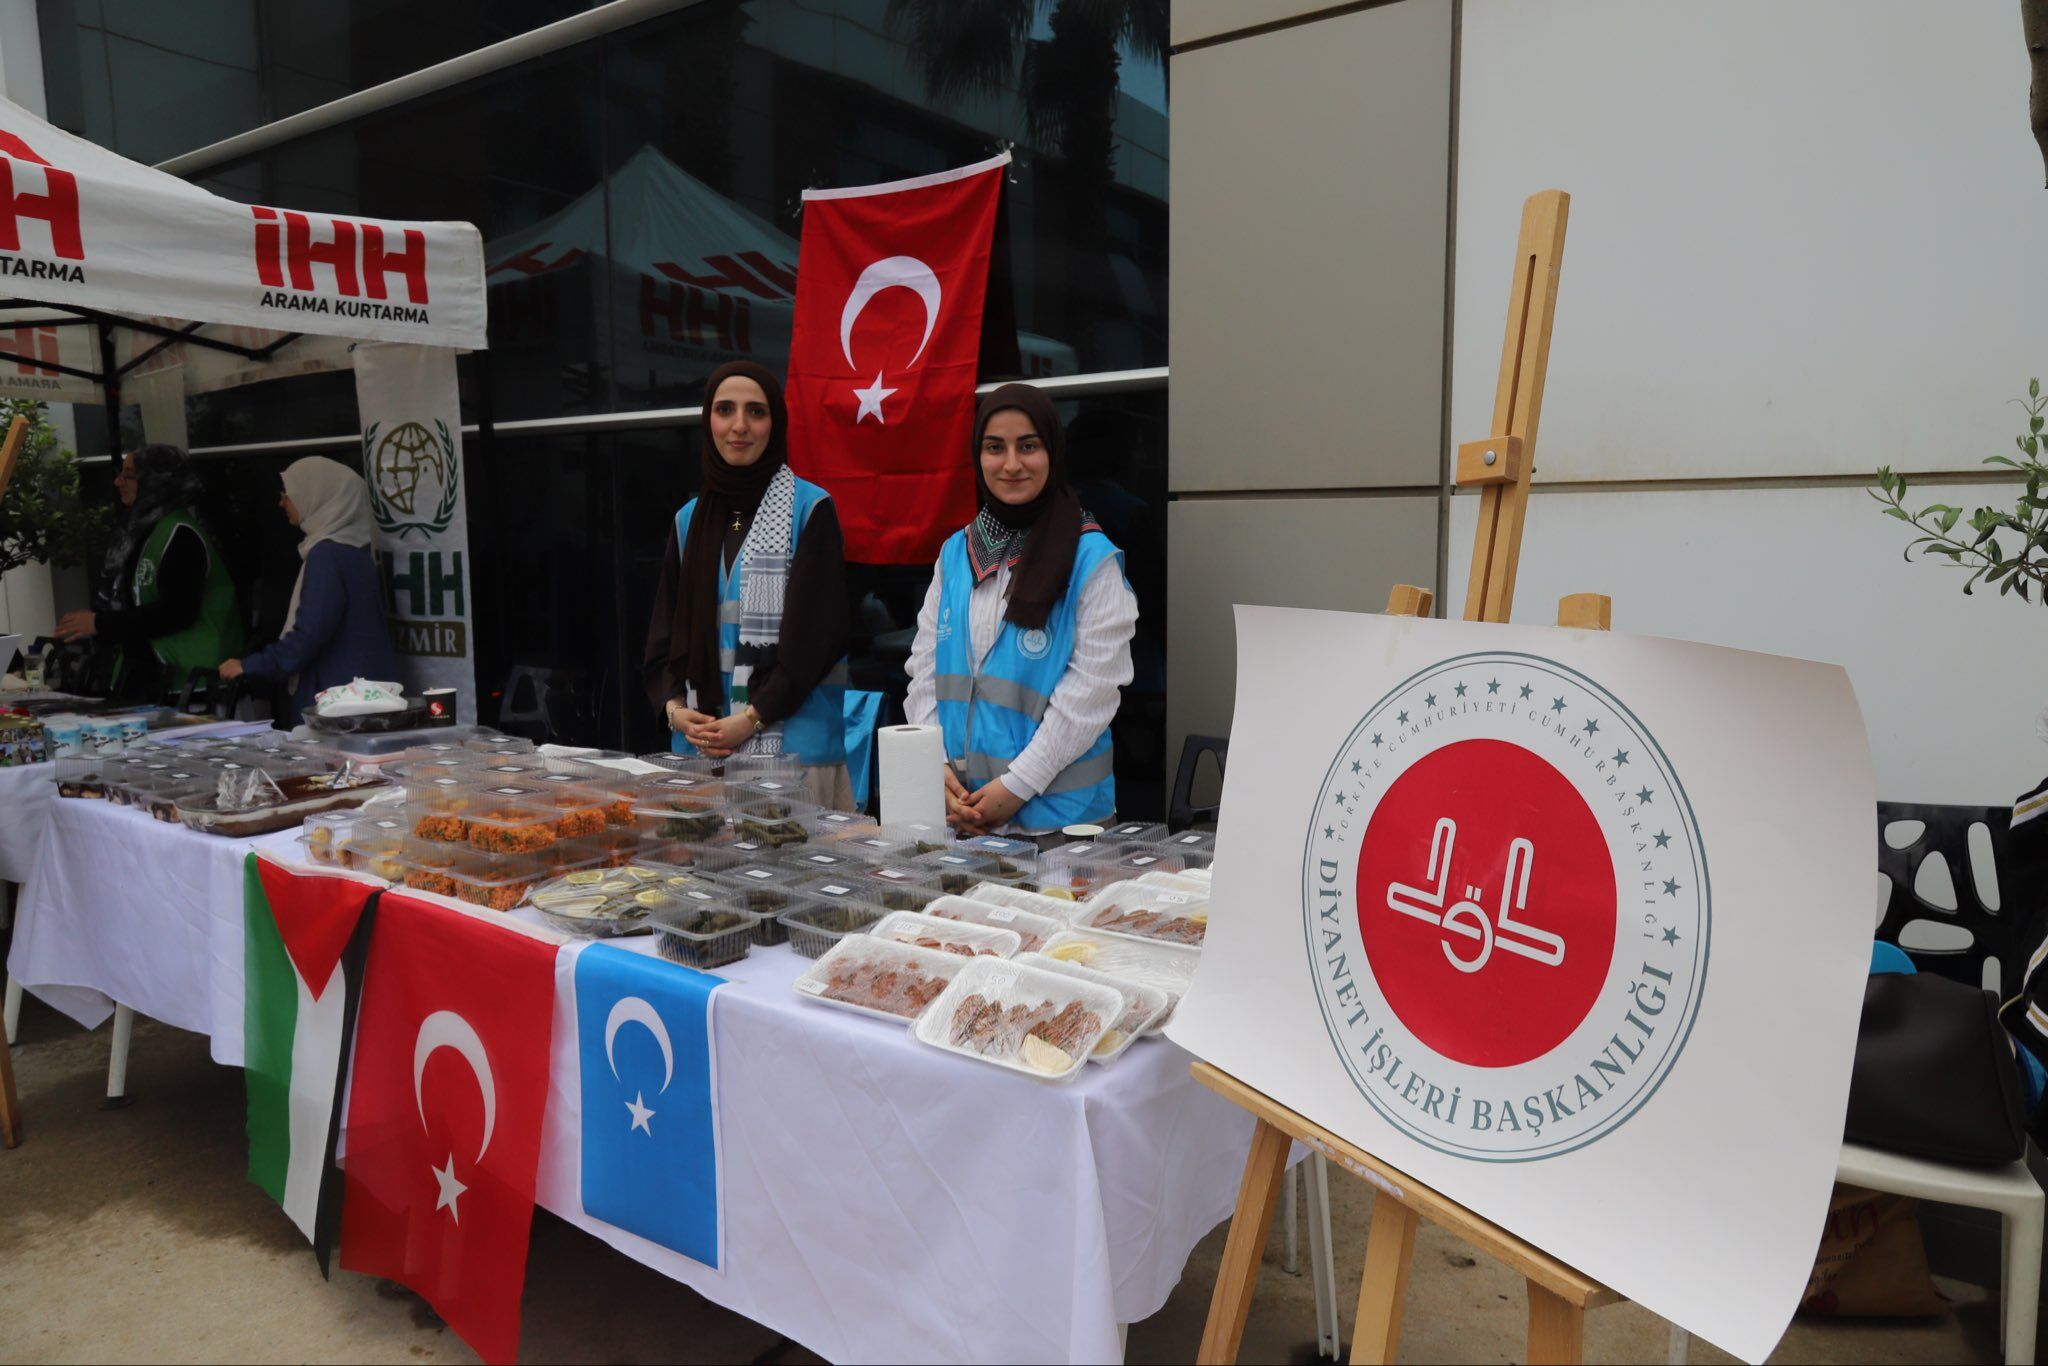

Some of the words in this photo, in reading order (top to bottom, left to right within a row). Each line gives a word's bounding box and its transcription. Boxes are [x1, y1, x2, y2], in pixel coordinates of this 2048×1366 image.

[260, 291, 329, 313] ARAMA
[334, 300, 429, 324] KURTARMA
[381, 551, 465, 616] HH
[1388, 701, 1517, 753] CUMHURİYETİ
[1528, 710, 1658, 940] CUMHURBAŞKANLIĞI
[1318, 857, 1370, 1029] DİYANET
[1360, 1027, 1462, 1125] İŞLERİ
[1470, 961, 1674, 1138] BAŞKANLIĞI
